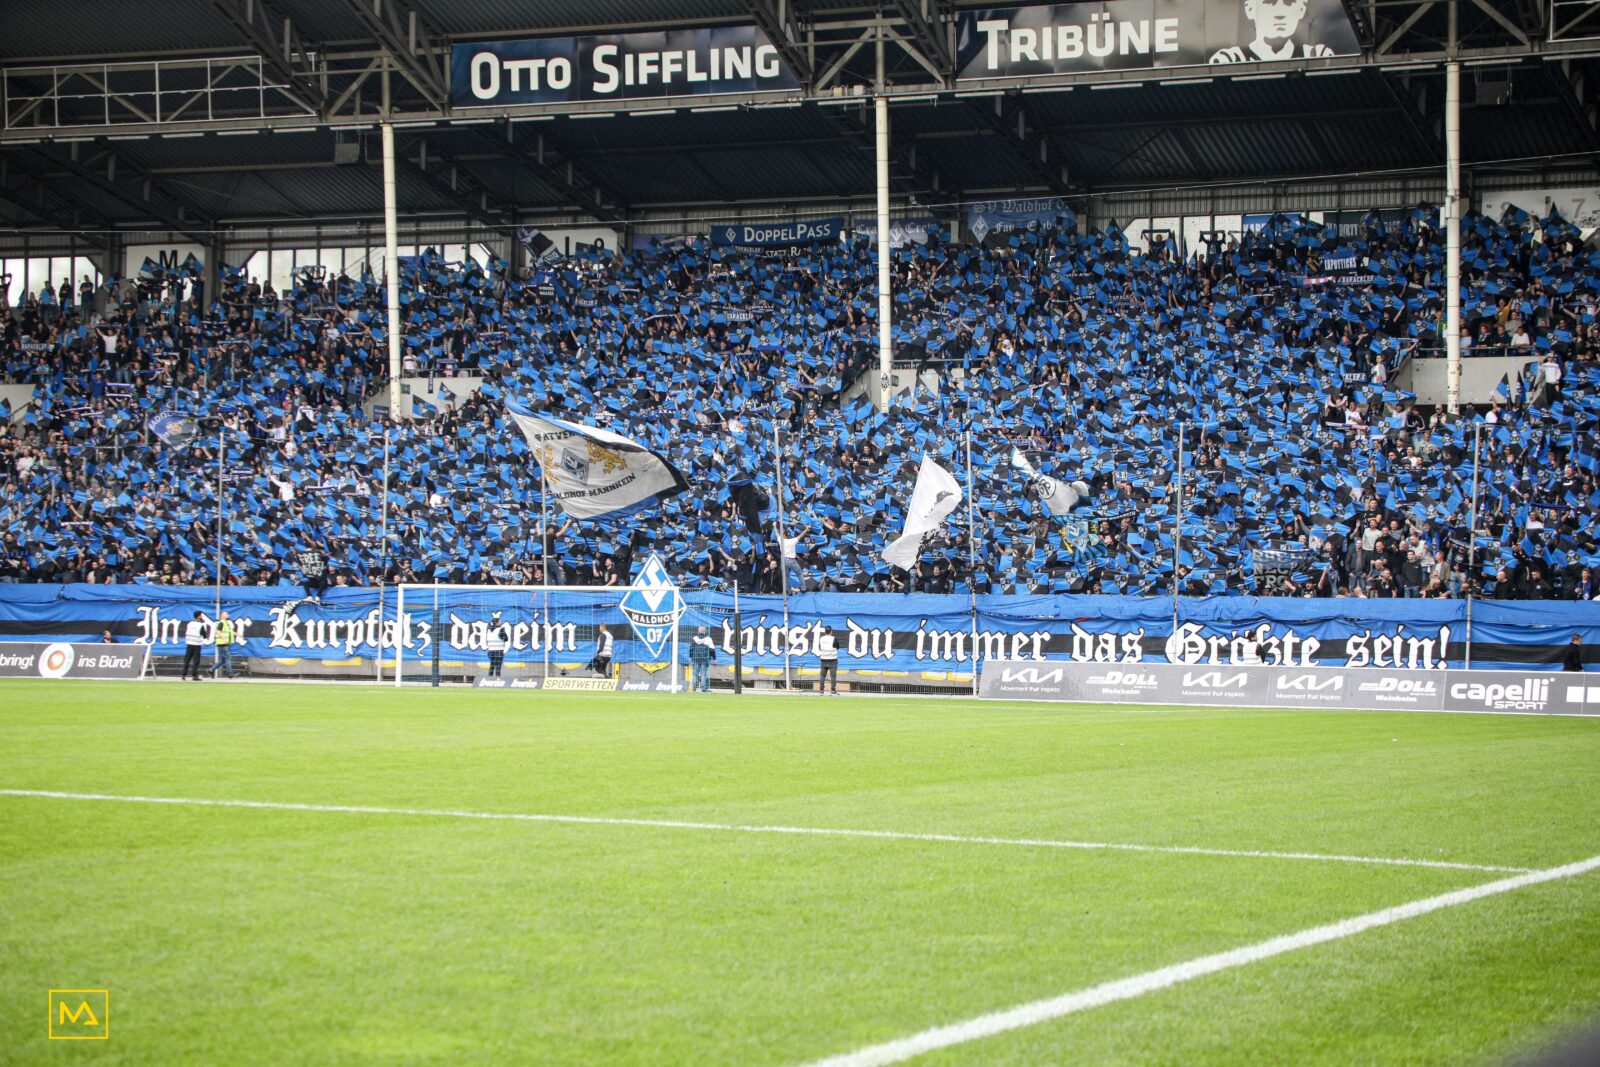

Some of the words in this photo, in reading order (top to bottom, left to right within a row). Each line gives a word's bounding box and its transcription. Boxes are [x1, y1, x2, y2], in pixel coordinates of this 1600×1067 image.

[470, 51, 572, 100] OTTO
[592, 44, 781, 94] SIFFLING
[976, 12, 1180, 71] TRIBÜNE
[646, 627, 664, 643] 07
[847, 617, 896, 660] du
[915, 619, 1052, 662] immer
[1070, 622, 1145, 663] das
[1344, 624, 1452, 670] sein!
[78, 655, 97, 668] ins
[98, 655, 134, 669] Büro!
[1001, 667, 1063, 683] KIA
[1182, 671, 1248, 688] KIA
[1276, 674, 1344, 691] KIA
[545, 679, 615, 690] SPORTWETTEN
[1102, 687, 1140, 695] Weinheim
[1181, 689, 1211, 697] Movement
[1275, 692, 1306, 700] Movement
[1375, 694, 1418, 702] Weinheim
[1450, 678, 1551, 707] capelli
[1493, 700, 1548, 710] SPORT
